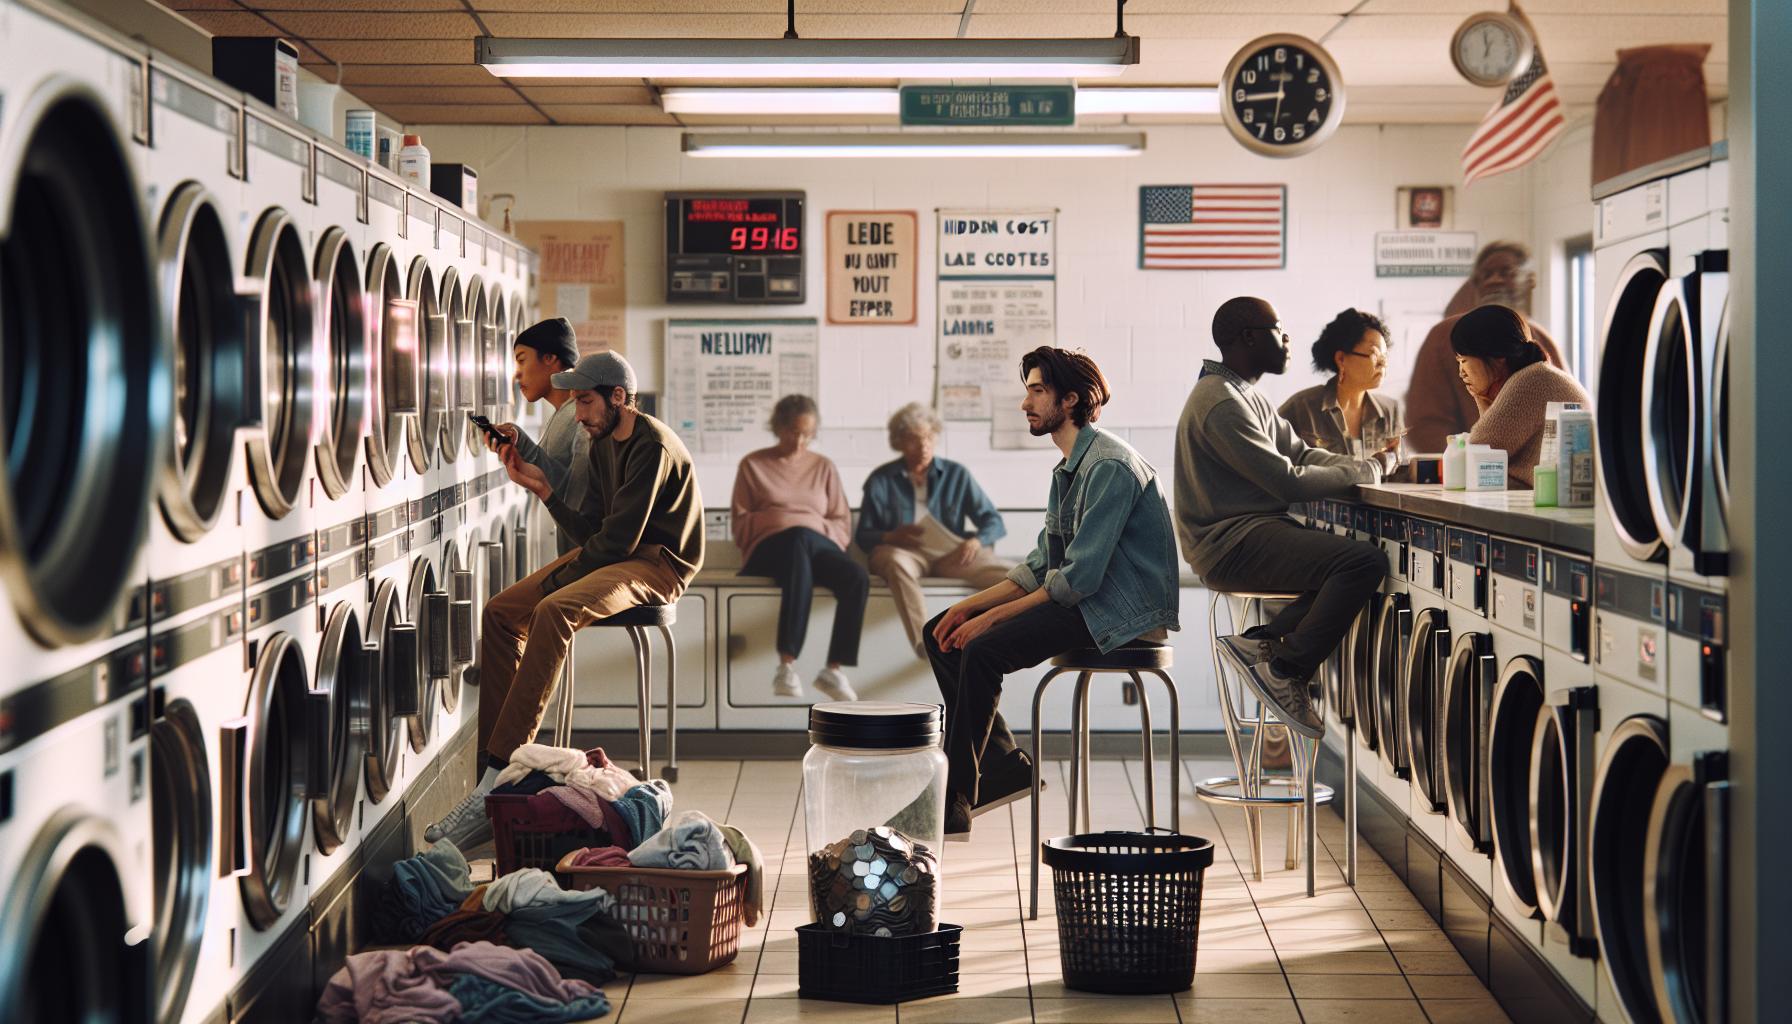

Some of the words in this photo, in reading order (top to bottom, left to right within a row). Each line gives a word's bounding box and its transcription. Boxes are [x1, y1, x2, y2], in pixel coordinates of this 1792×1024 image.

[1296, 54, 1304, 70] 1
[1242, 70, 1256, 84] 10
[1256, 123, 1267, 138] 7
[848, 222, 894, 245] LEDE
